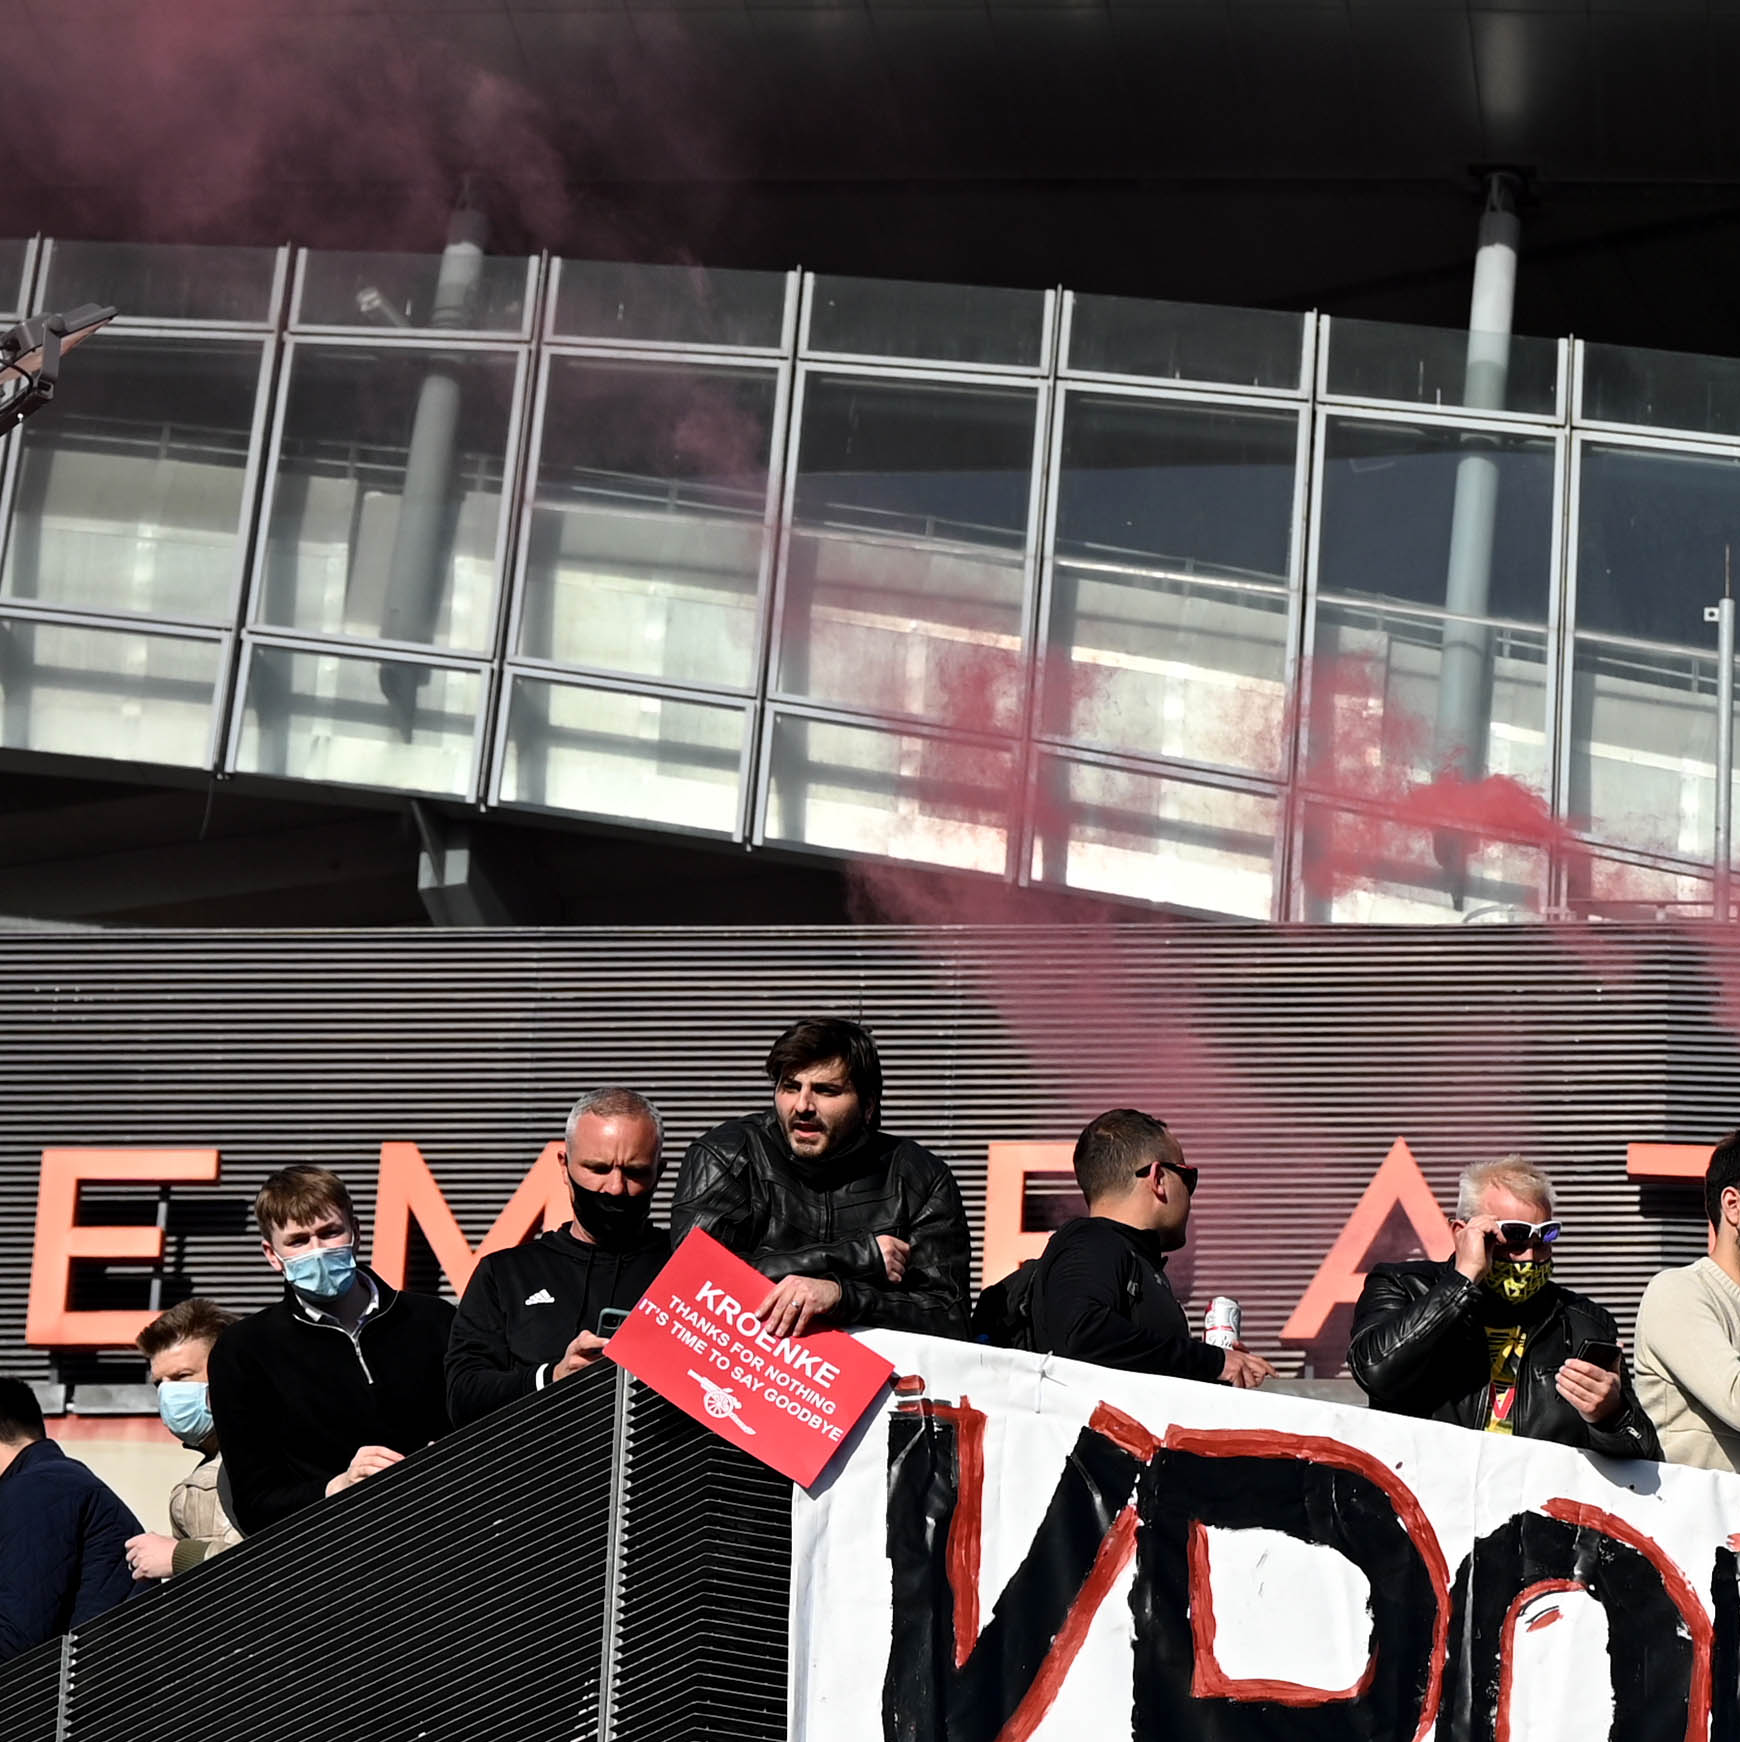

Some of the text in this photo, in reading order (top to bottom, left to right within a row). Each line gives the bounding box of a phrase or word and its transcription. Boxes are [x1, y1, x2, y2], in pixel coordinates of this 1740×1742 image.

[638, 1297, 844, 1441] IT'S TIME TO SAY GOODBYE
[669, 1294, 836, 1415] THANKS FOR NOTHING
[695, 1280, 841, 1388] KROENKE
